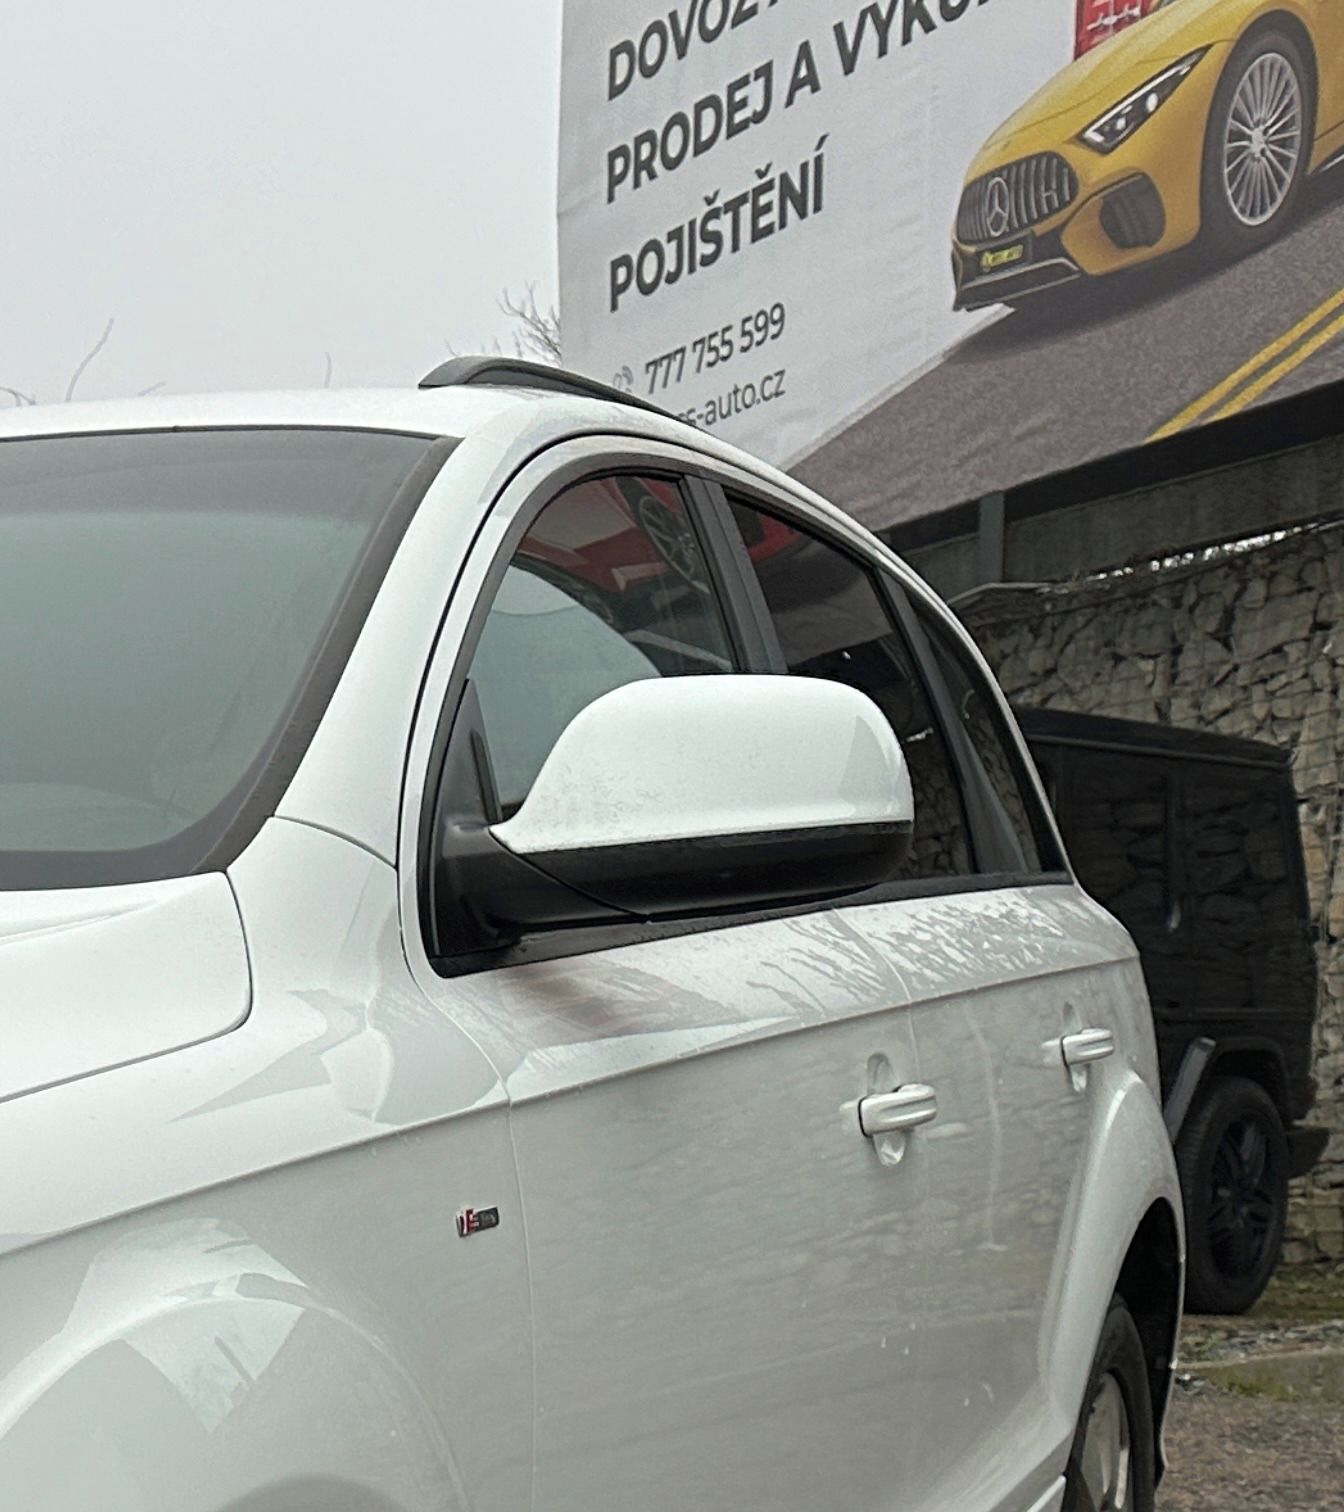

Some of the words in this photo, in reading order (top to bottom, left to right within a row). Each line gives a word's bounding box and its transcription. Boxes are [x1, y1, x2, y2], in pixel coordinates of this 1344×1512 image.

[607, 0, 778, 101] DOVO
[607, 60, 774, 204] PRODEJ
[785, 39, 821, 109] A
[832, 0, 990, 76] VYK
[610, 133, 830, 313] POJIŠTĚNÍ
[645, 345, 687, 394] 777
[692, 325, 734, 374] 755
[740, 302, 786, 353] 599
